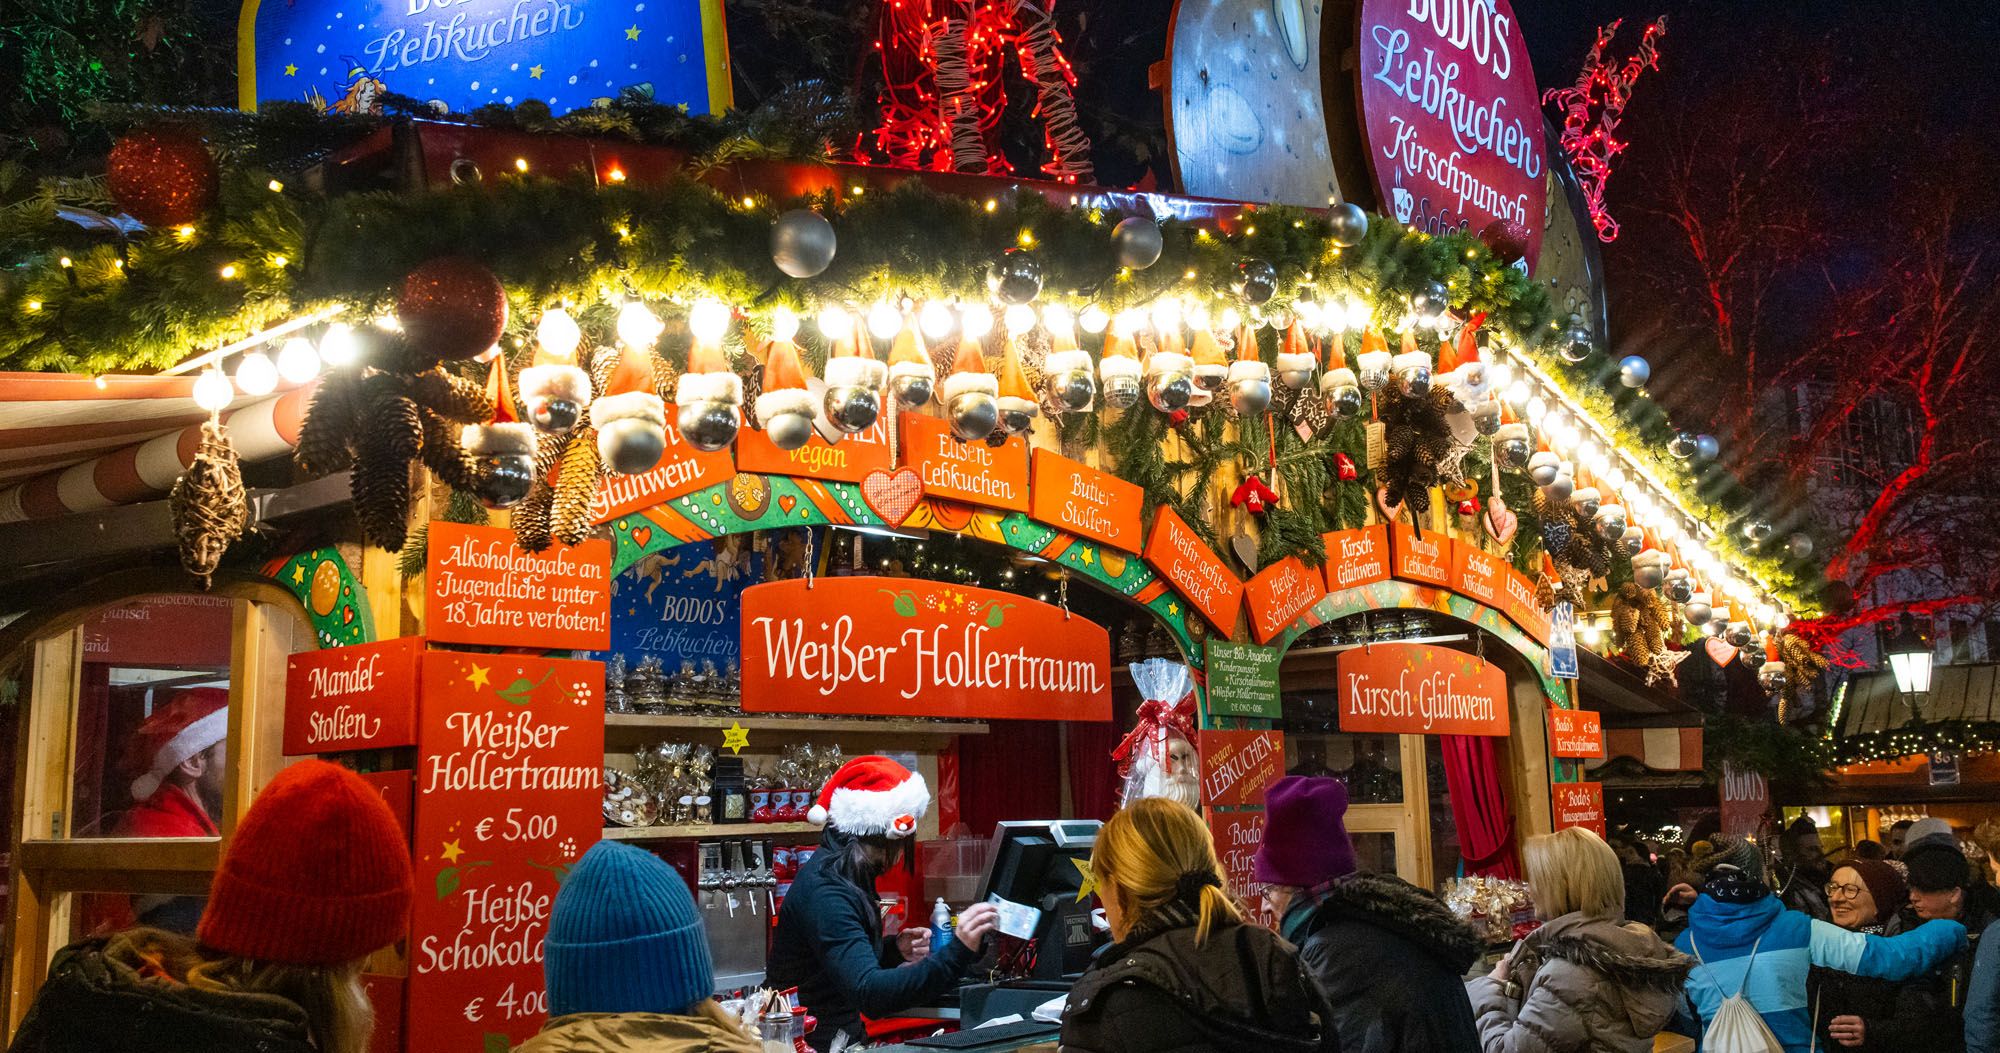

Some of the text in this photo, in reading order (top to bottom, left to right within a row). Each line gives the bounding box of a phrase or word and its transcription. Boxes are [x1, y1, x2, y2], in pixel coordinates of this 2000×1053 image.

[364, 0, 584, 73] Lebkuchen
[1372, 25, 1540, 179] Lebkuchen
[1383, 115, 1528, 228] Kirschpunsch
[790, 445, 848, 473] vegan
[922, 460, 1016, 500] Lebkuchen
[1070, 473, 1115, 507] Butter-
[1061, 500, 1120, 538] Stollen
[440, 539, 603, 582] Alkoholabgabe an
[1169, 520, 1233, 595] Weihnachts-
[1340, 530, 1375, 559] Kirsch-
[1407, 535, 1440, 562] Walnuß
[1337, 557, 1382, 587] Glühwein
[1403, 555, 1448, 582] Lebkuchen
[1467, 554, 1495, 576] Schoko-
[436, 571, 599, 605] Jugendliche unter
[1169, 558, 1216, 615] Gebäck
[1270, 566, 1298, 604] Heiße
[1462, 573, 1494, 600] Nikolaus
[443, 599, 606, 633] 18 Jahre verboten!
[1264, 577, 1317, 632] Schokolade
[634, 626, 740, 659] Lebkuchen
[752, 614, 1106, 699] Weißer Hollertraum
[308, 653, 384, 699] Mandel-
[1347, 669, 1496, 730] Kirsch Glühwein
[307, 705, 382, 745] Stollen
[445, 710, 569, 760] Weißer
[1554, 716, 1574, 732] Bodo's
[423, 749, 602, 794] Hollertraum
[1205, 731, 1273, 801] LEBKUCHEN
[1207, 743, 1234, 769] vegan
[1239, 758, 1275, 804] glutenfrei
[1568, 789, 1591, 806] Bodo's
[474, 816, 495, 842] €
[462, 880, 550, 933] Heiße
[463, 996, 484, 1023] €
